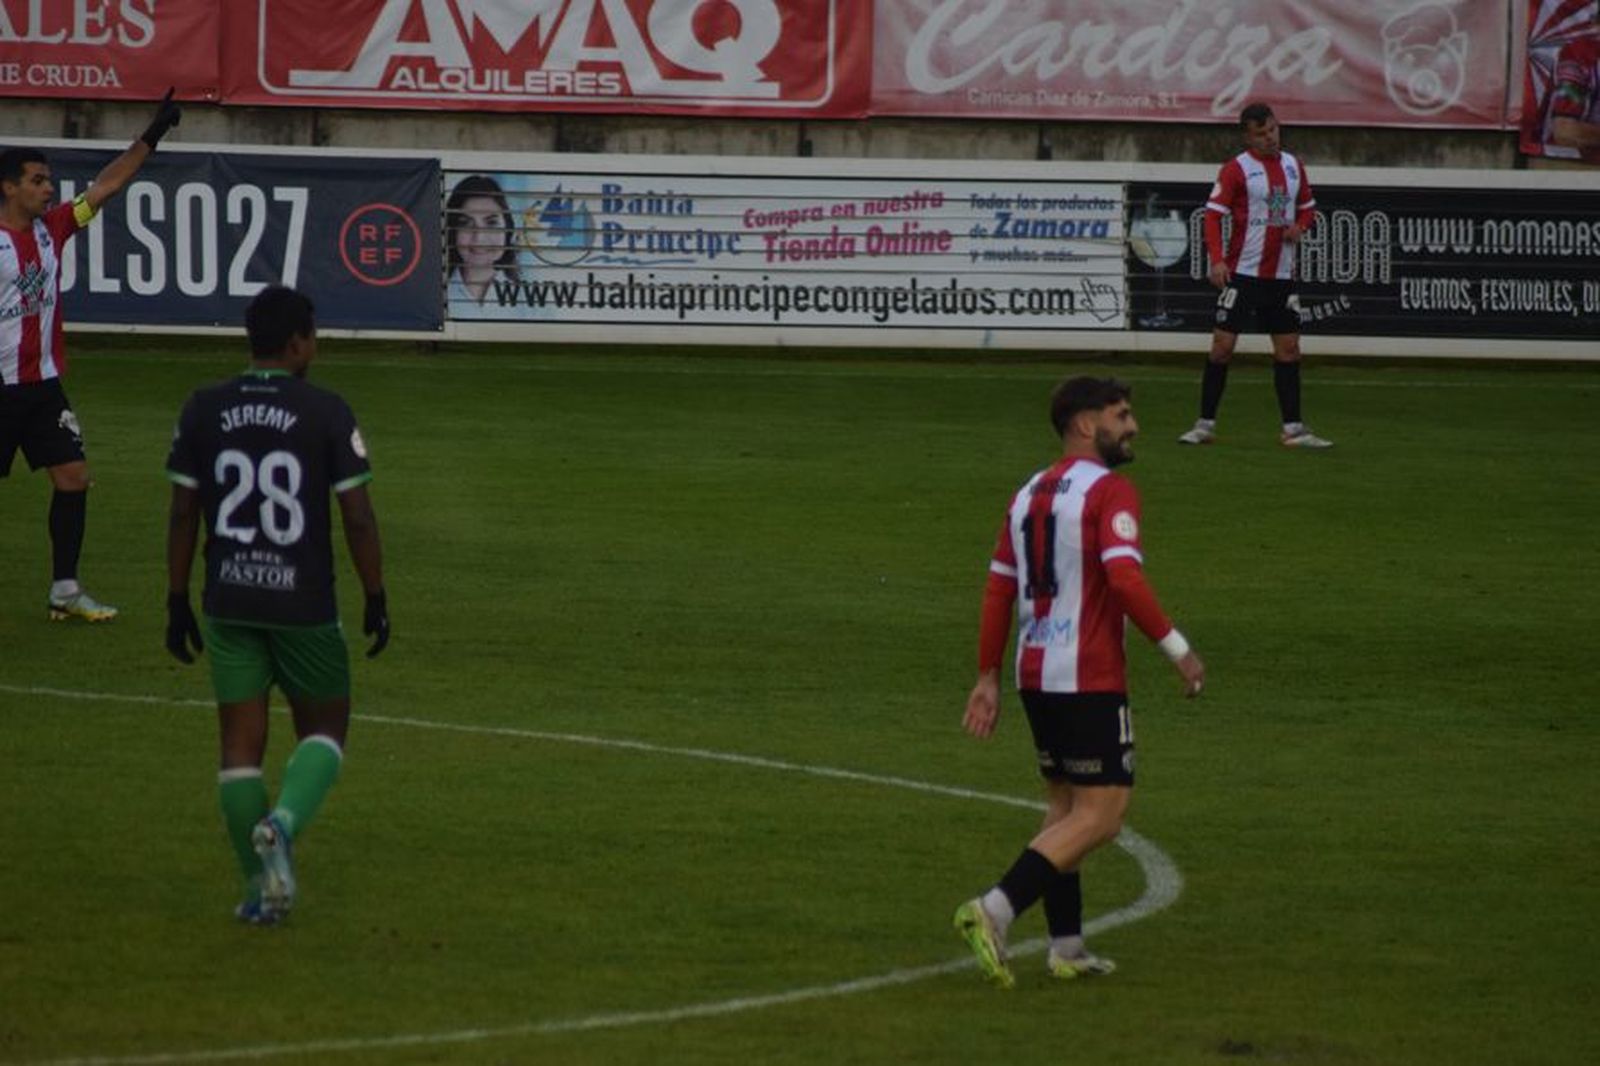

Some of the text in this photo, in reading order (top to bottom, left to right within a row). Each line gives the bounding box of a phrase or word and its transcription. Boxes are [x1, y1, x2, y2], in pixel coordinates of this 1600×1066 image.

[289, 0, 782, 98] AMAQ
[905, 0, 1343, 116] Cardiza
[26, 63, 121, 88] CRUDA
[390, 67, 622, 95] ALQUILERES
[743, 189, 944, 228] Compra en nuestra
[970, 193, 1116, 212] Todos los productos
[763, 221, 953, 263] Tienda Online
[970, 211, 1110, 239] de Zamora
[492, 272, 1075, 322] www.bahiaprincipecongelados.com
[220, 404, 299, 433] JEREMY
[214, 449, 305, 546] 28
[220, 560, 296, 591] PASTOR
[1021, 512, 1059, 600] 11
